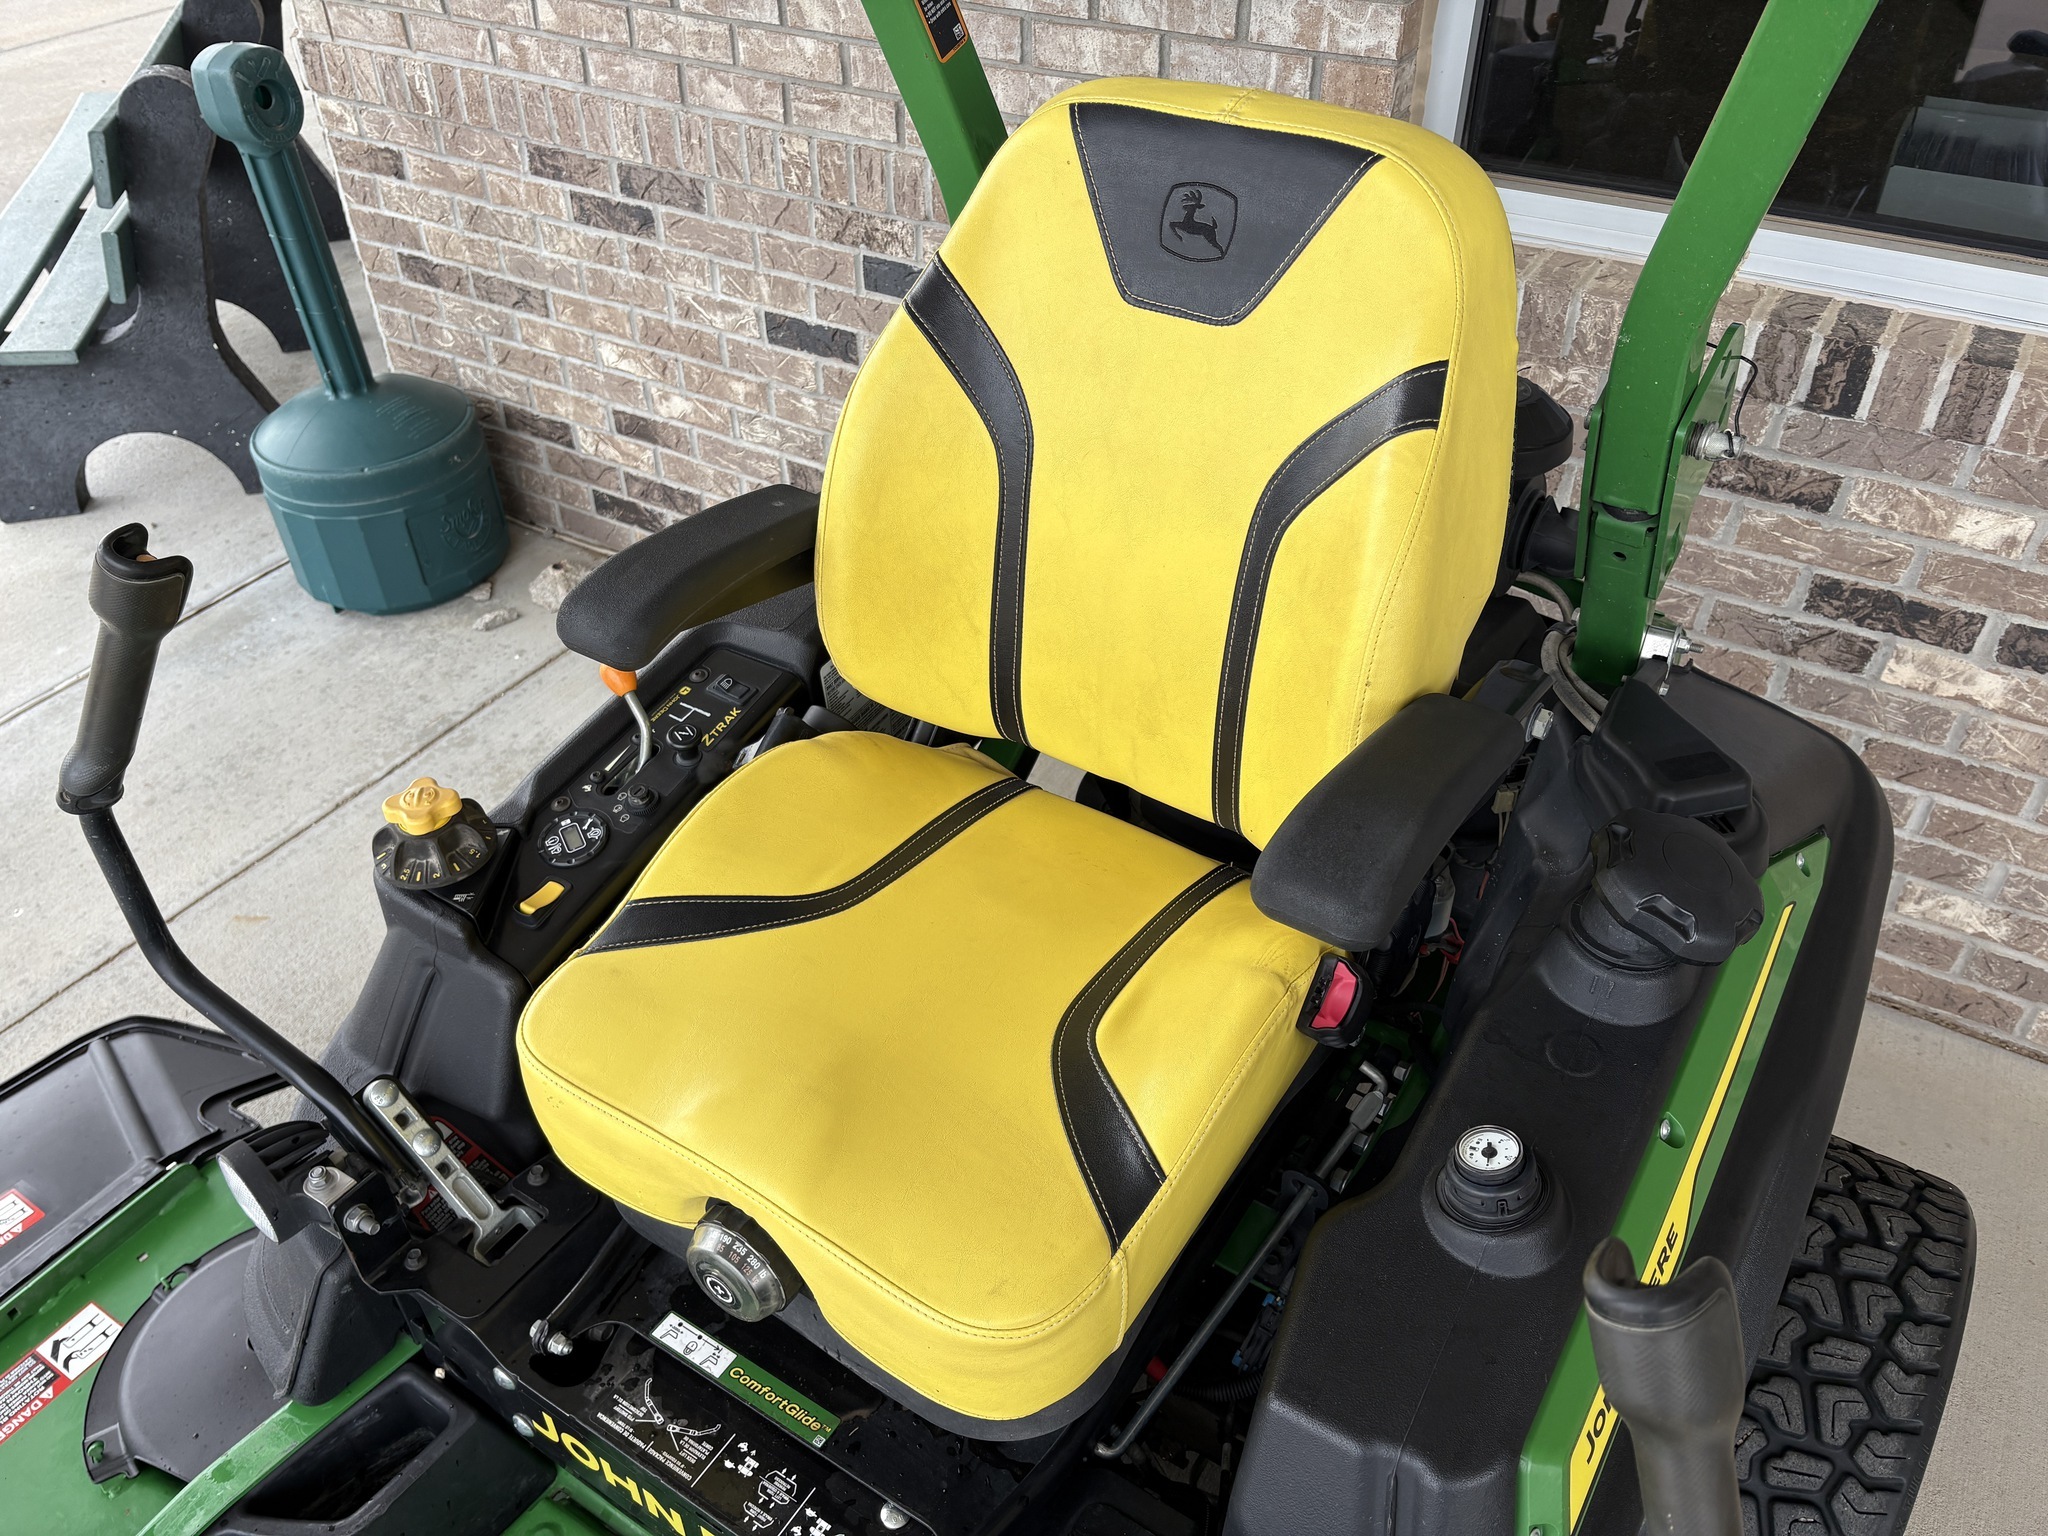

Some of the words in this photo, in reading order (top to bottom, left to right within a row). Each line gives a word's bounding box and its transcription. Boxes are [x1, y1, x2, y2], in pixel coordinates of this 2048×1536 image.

[701, 707, 741, 746] ZTRAK
[400, 868, 410, 880] 2.5
[720, 1234, 732, 1244] 190
[733, 1241, 747, 1255] 235
[747, 1255, 760, 1269] 280
[758, 1269, 766, 1278] lb
[729, 1251, 740, 1263] 105
[742, 1263, 752, 1276] 125
[1650, 1222, 1678, 1286] ERE
[7, 1385, 45, 1417] ROTATING
[597, 1412, 624, 1434] CONVENIENCIA
[1586, 1394, 1614, 1464] JO
[628, 1434, 647, 1449] PAQUETE
[648, 1448, 666, 1463] PACKAGE
[532, 1412, 686, 1536] JOHN
[665, 1459, 692, 1481] CONVENIENCE
